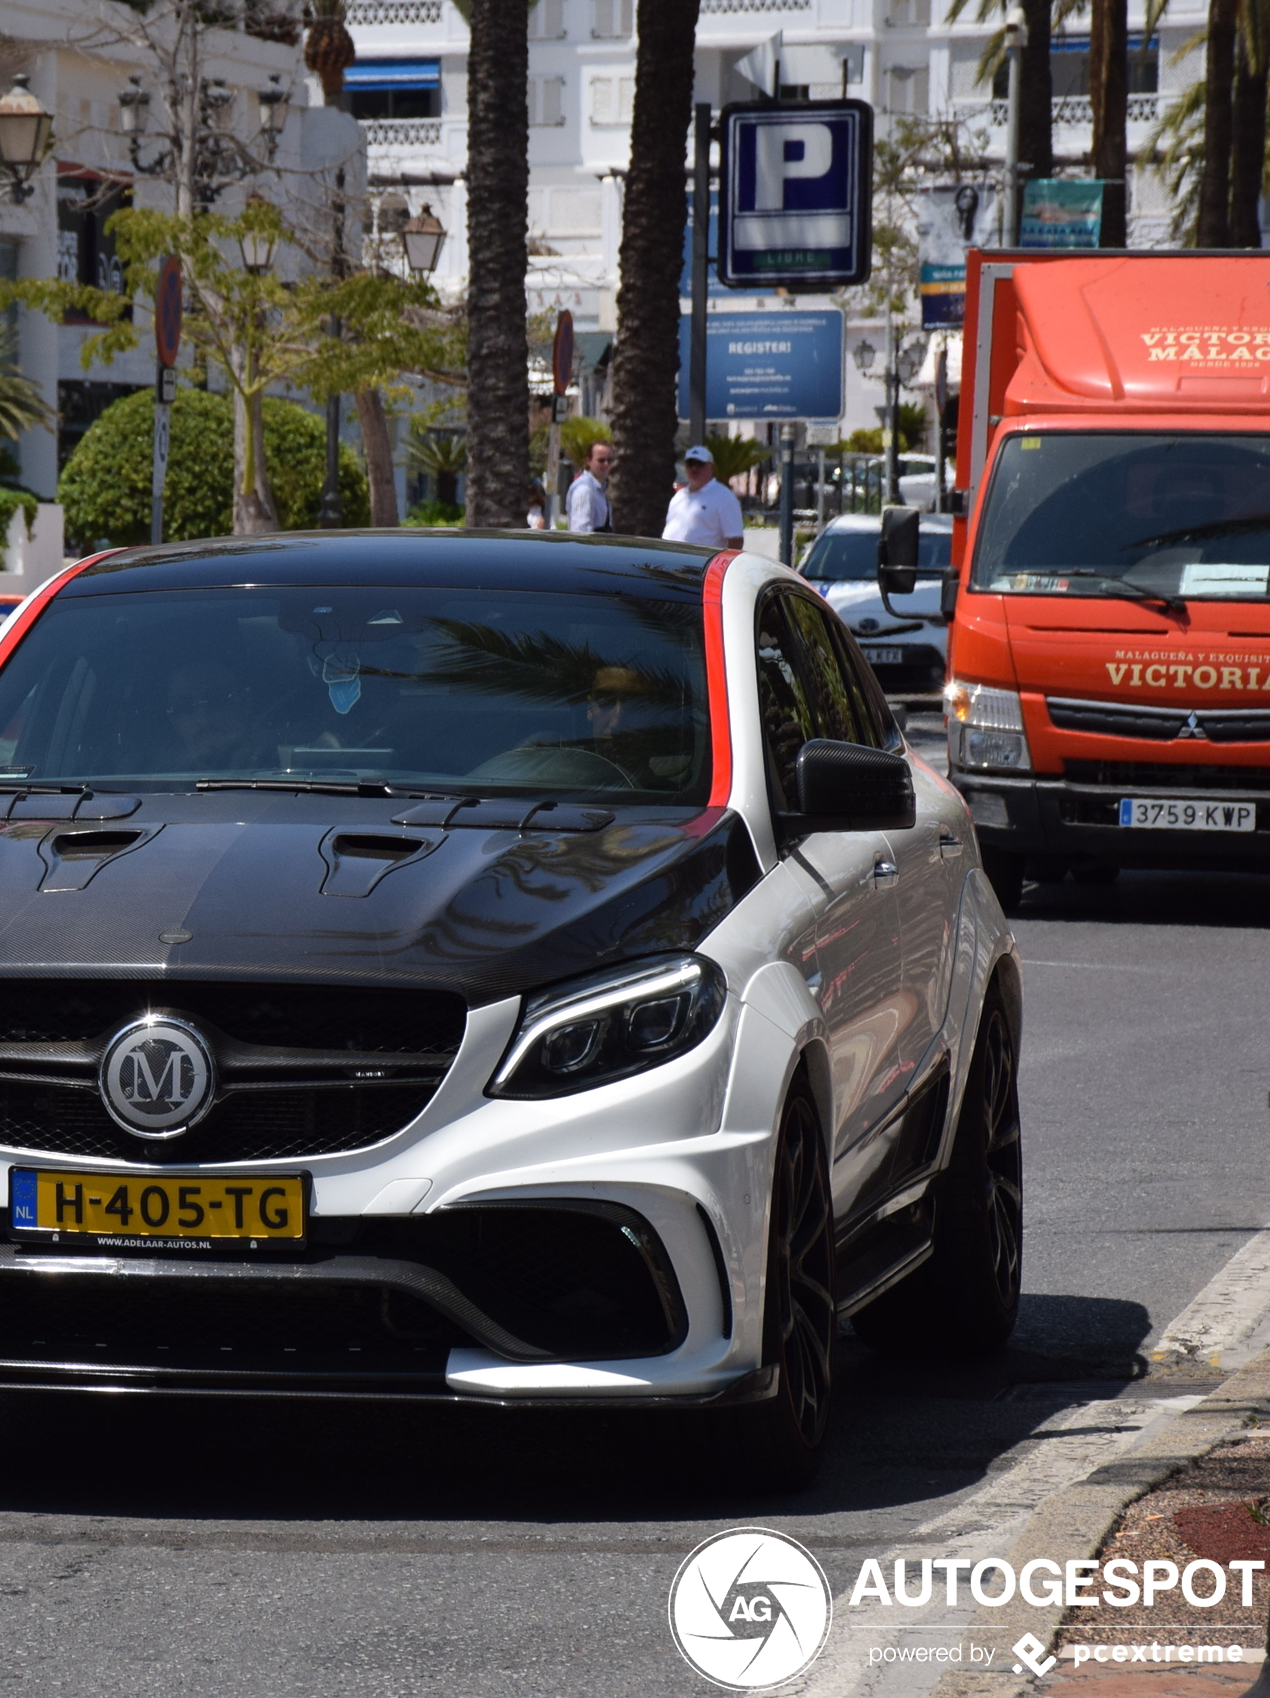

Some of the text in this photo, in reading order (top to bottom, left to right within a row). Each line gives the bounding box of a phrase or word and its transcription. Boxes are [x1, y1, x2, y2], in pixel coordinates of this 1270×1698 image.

[755, 123, 833, 211] P
[1115, 650, 1194, 661] MALAGUEÑA
[1198, 652, 1206, 661] Y
[1137, 804, 1250, 828] 3759 KWP
[126, 1050, 190, 1103] M
[15, 1205, 34, 1220] NL
[55, 1181, 289, 1230] H-405-TG
[97, 1236, 212, 1250] WWW.ADELAAR-AUTOS.NL
